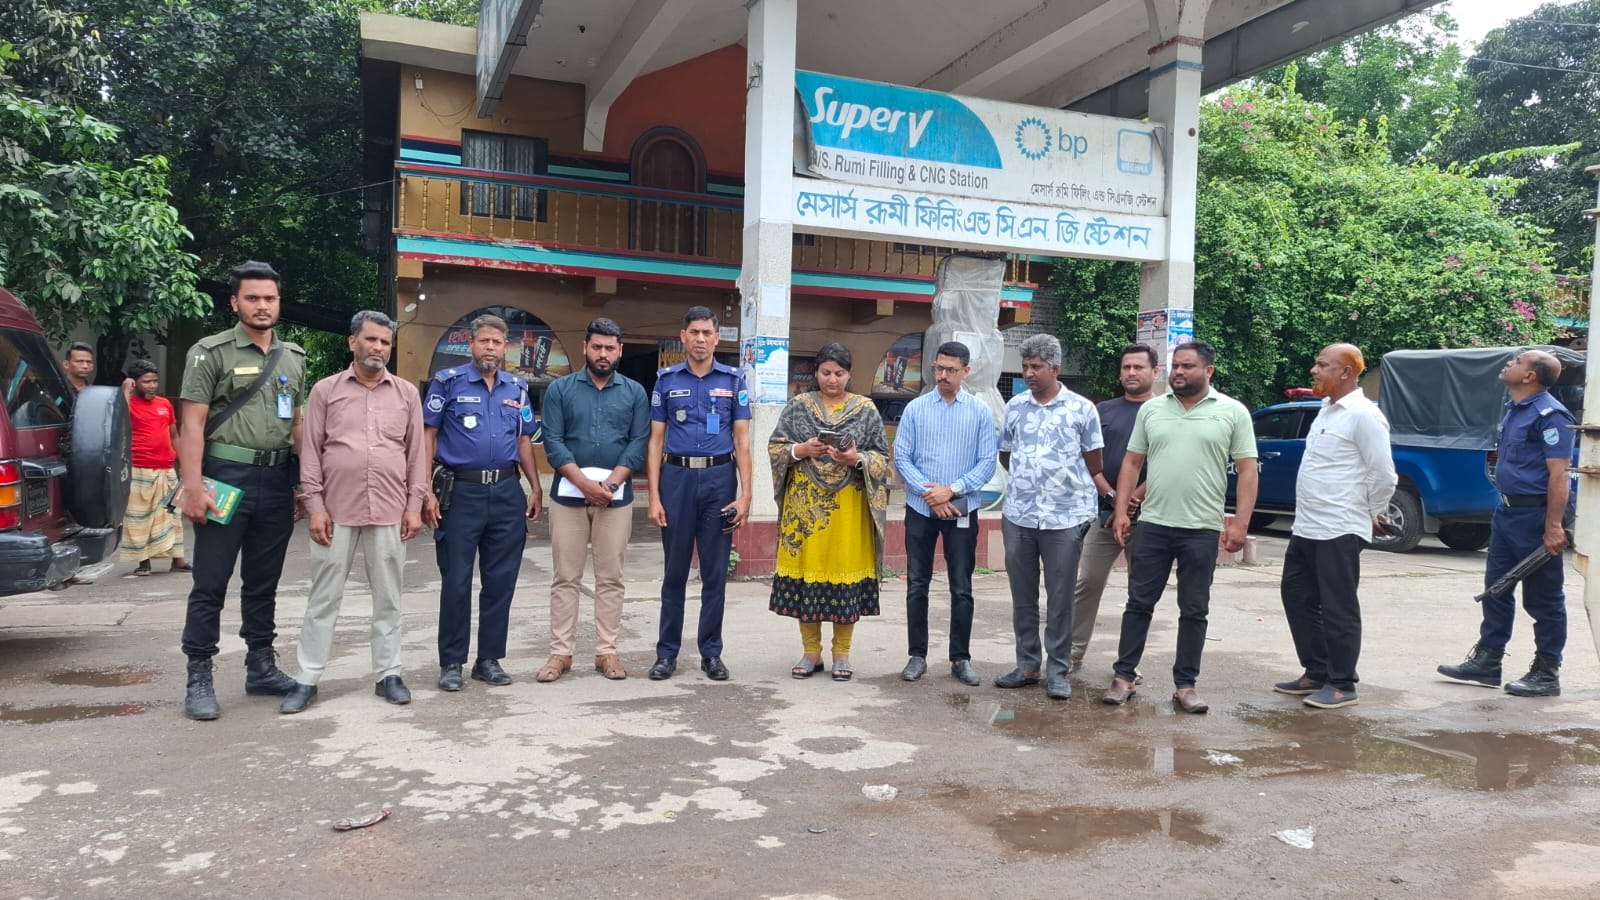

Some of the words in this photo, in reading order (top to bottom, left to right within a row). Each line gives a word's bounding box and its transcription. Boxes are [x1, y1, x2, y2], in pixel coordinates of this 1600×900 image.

[810, 86, 906, 139] Super
[1058, 127, 1088, 159] bp
[835, 154, 866, 172] Rumi
[869, 159, 905, 182] Filling
[908, 164, 916, 182] &
[919, 166, 946, 185] CNG
[949, 169, 988, 190] Station
[796, 188, 860, 221] মেসার্স
[863, 194, 911, 228] রূমী
[1030, 180, 1054, 197] মেসার্স
[1070, 183, 1091, 201] ফিলিং
